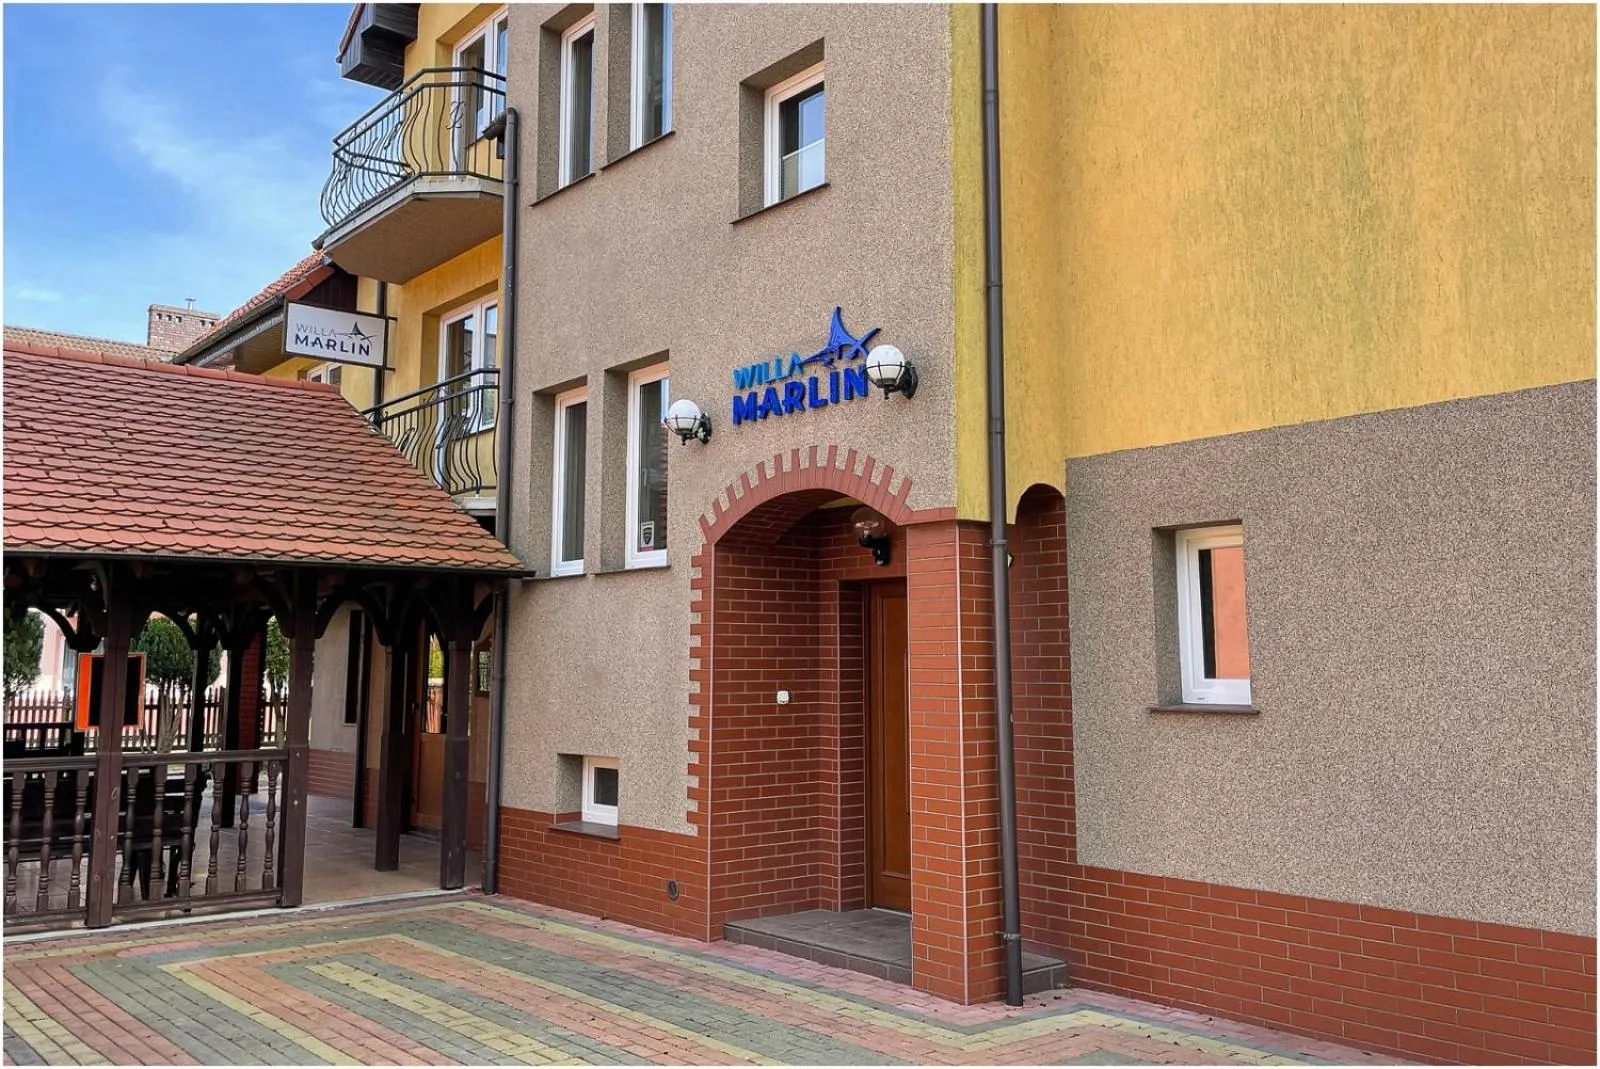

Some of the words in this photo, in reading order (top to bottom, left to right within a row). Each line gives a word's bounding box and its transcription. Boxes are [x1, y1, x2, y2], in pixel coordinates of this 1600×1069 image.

[295, 333, 370, 356] MARLIN
[296, 323, 337, 338] WILLA
[733, 351, 804, 390] WILLA
[732, 364, 868, 426] MARLIN
